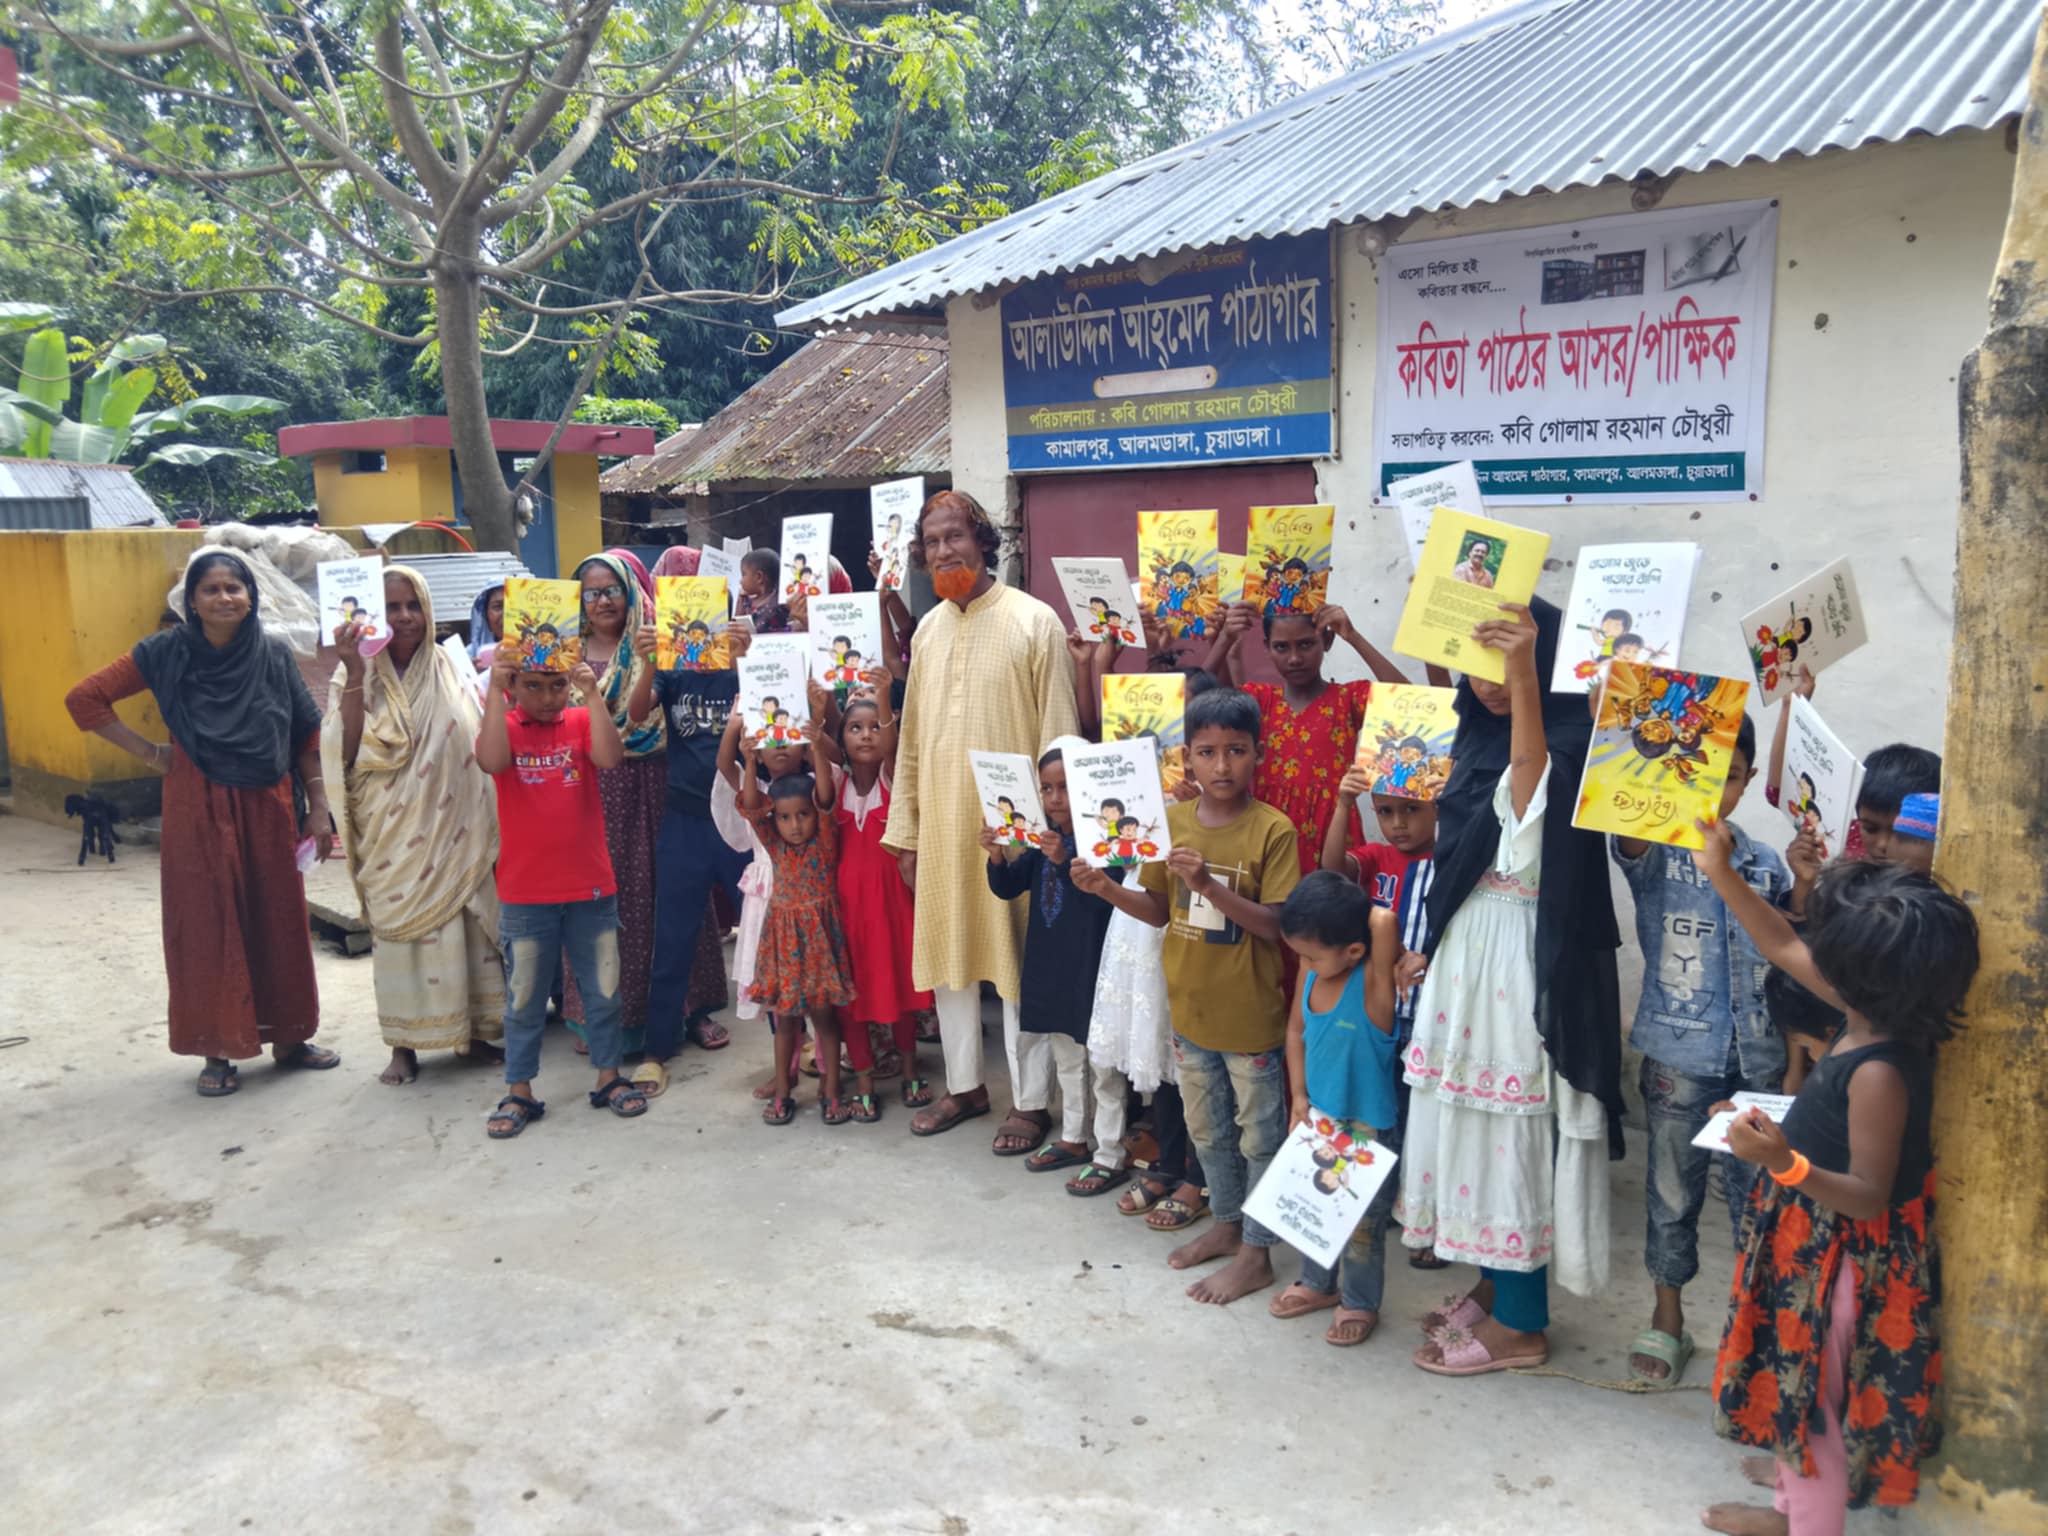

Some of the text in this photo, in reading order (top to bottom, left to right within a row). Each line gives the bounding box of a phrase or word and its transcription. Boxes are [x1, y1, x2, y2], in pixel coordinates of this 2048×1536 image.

[1398, 257, 1480, 280] এসো মিলিত হই
[1416, 283, 1458, 298] কবিতার
[1008, 293, 1115, 372] আলাউদ্দিন
[1220, 258, 1321, 348] পাঠাগার
[1396, 319, 1470, 399] কবিতা
[1476, 304, 1551, 397] পাঠের
[1029, 408, 1096, 429] পরিচালনায়
[1110, 400, 1138, 422] কবি
[1142, 401, 1192, 422] গোলাম
[1194, 394, 1245, 418] রহমান
[1248, 384, 1299, 416] চৌধুরী
[1391, 427, 1448, 451] সভাপতিত্ব
[1499, 414, 1535, 445] কবি
[1539, 417, 1600, 443] গোলাম
[1604, 414, 1666, 442] রহমান
[1672, 403, 1734, 443] চৌধুরী
[1045, 437, 1114, 460] কামালপুর,
